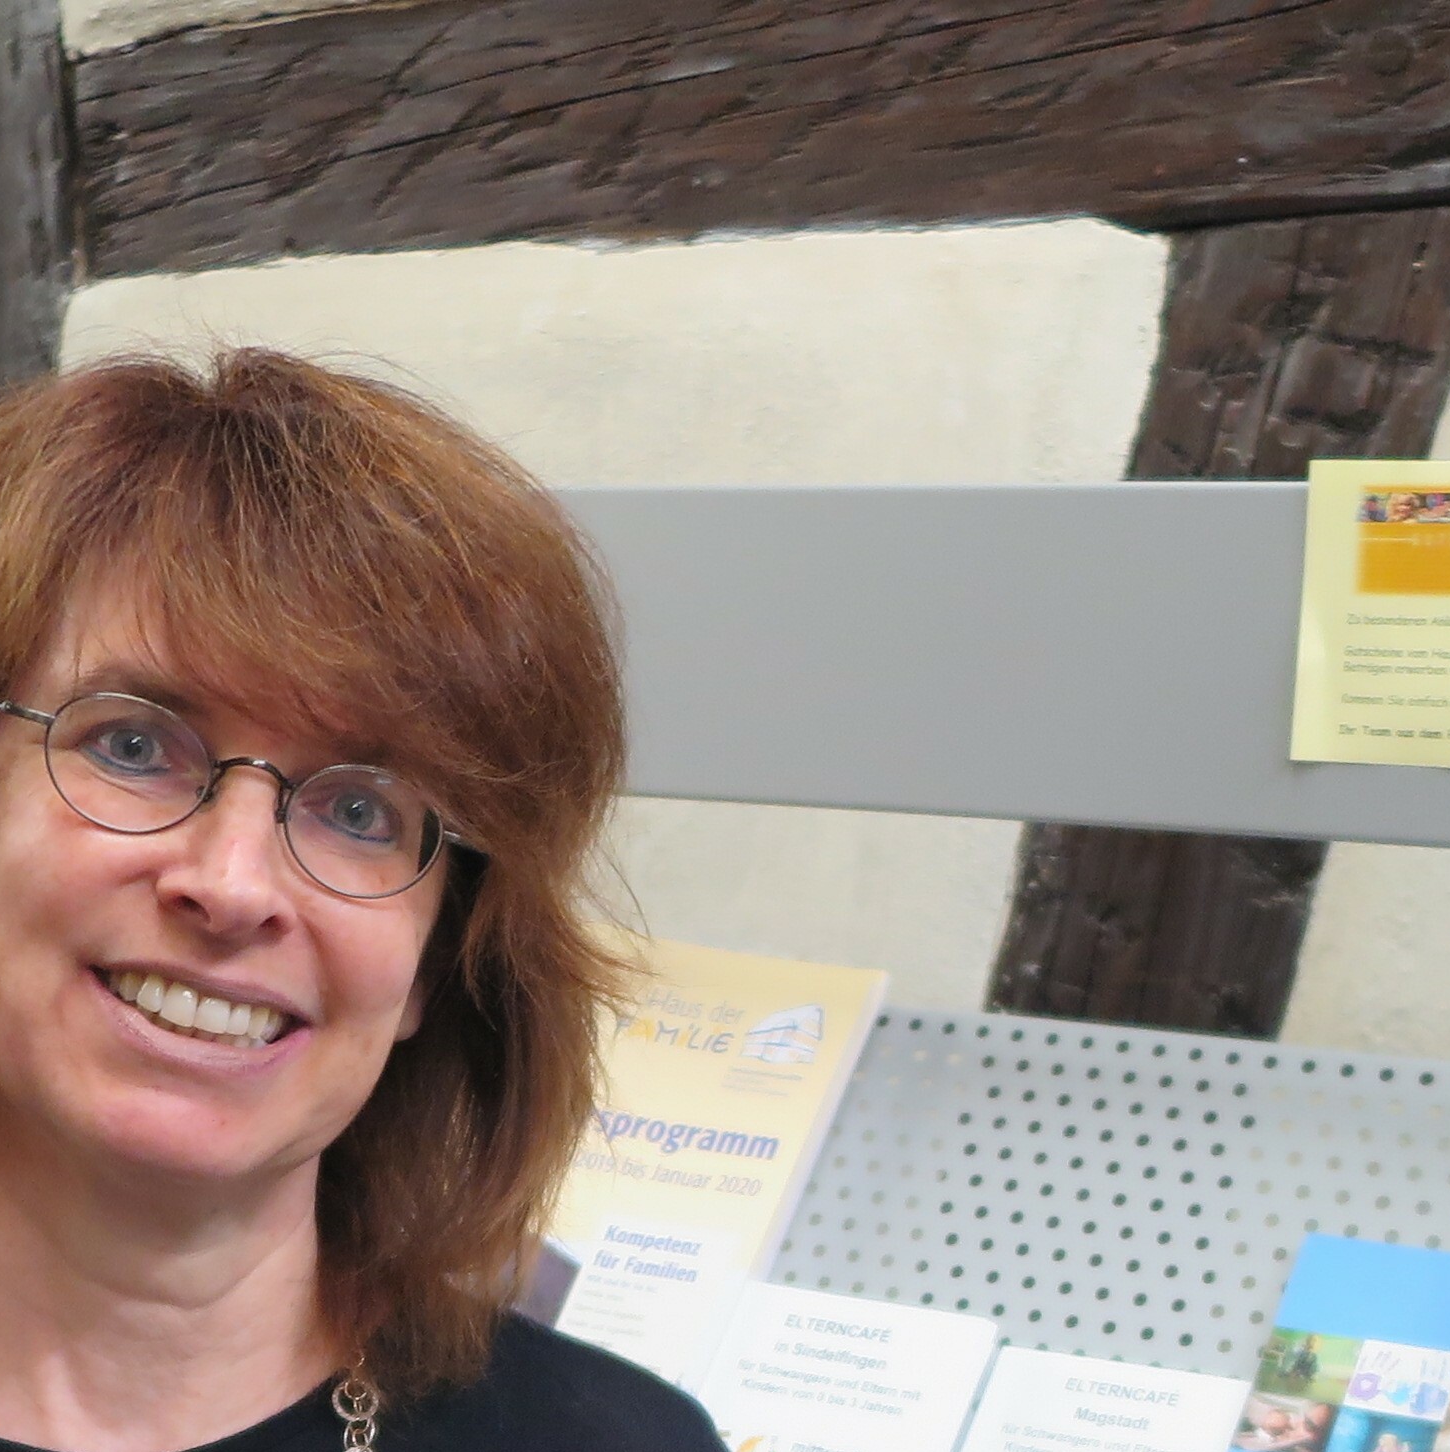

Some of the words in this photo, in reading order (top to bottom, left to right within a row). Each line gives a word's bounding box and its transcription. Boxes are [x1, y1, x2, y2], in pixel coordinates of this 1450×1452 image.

[711, 1000, 744, 1025] der
[652, 1163, 712, 1189] Januar
[716, 1174, 763, 1197] 2020
[603, 1224, 703, 1257] Kompetenz
[593, 1249, 621, 1271] für
[624, 1255, 700, 1283] Familien
[784, 1313, 891, 1343] ELTERNCAFÉ
[792, 1342, 887, 1370] Sindelfingen
[1064, 1377, 1180, 1408] ELTERNCAFÉ
[1073, 1406, 1150, 1431] Magstadt
